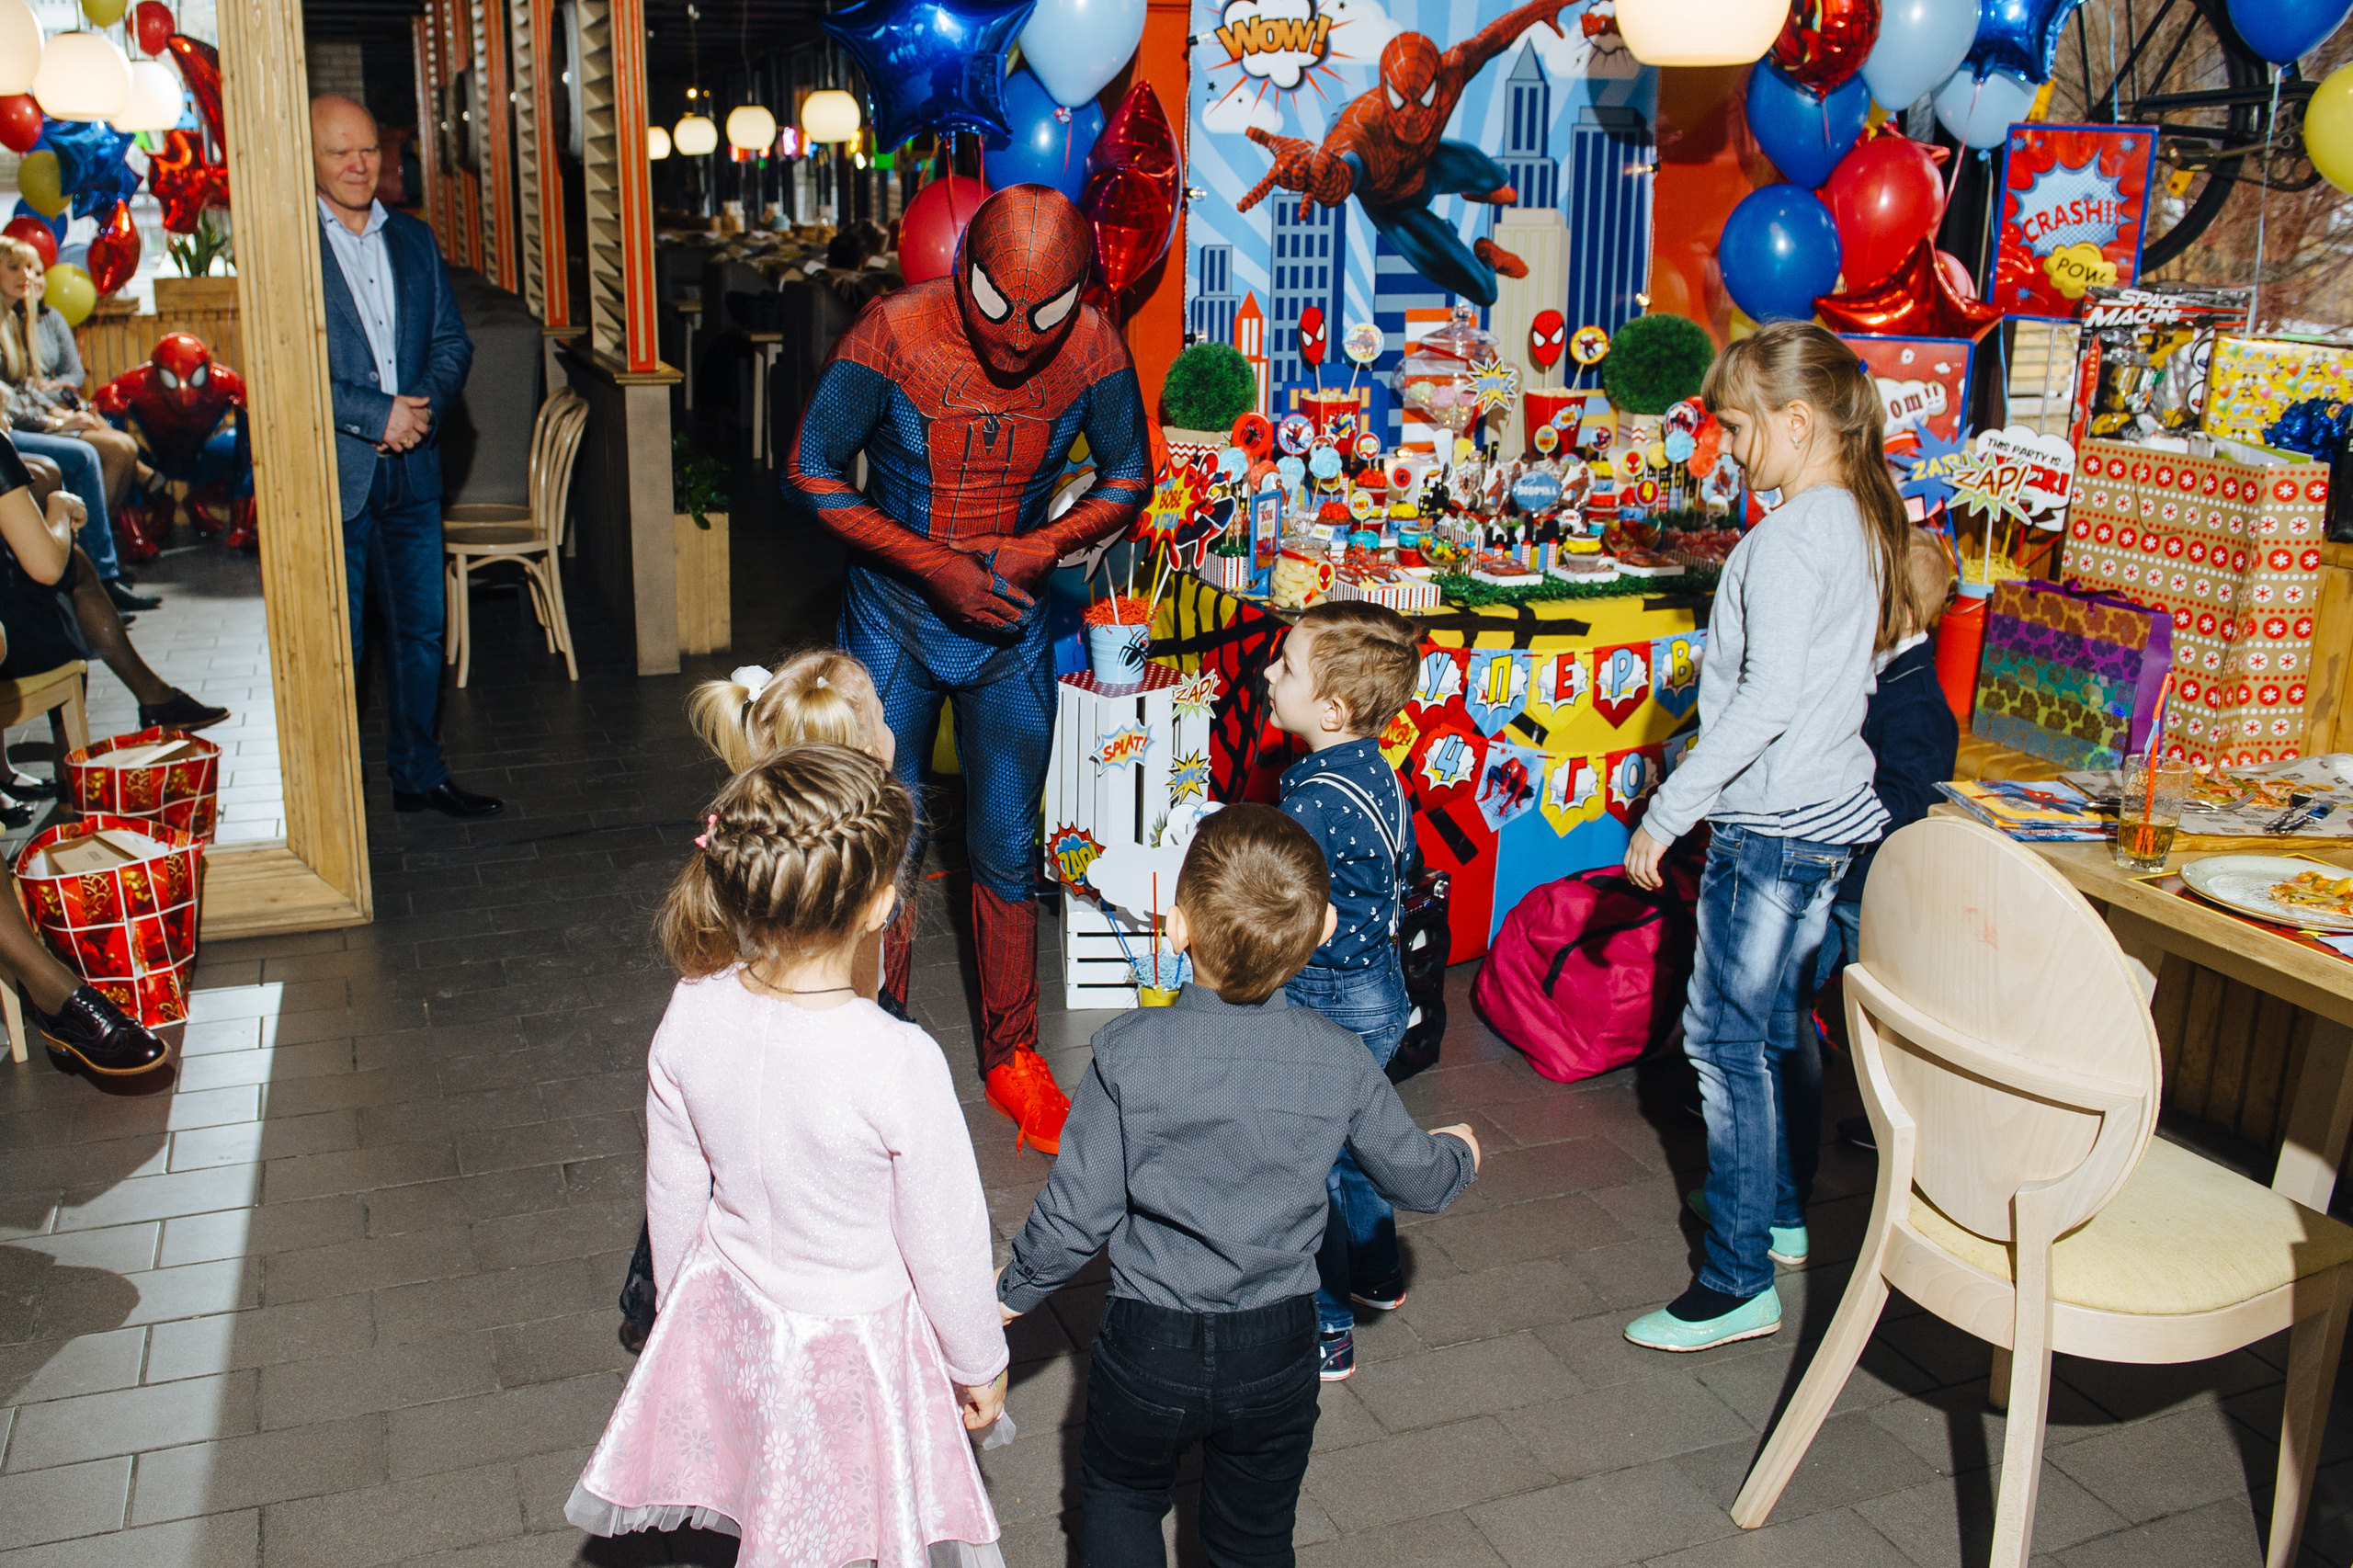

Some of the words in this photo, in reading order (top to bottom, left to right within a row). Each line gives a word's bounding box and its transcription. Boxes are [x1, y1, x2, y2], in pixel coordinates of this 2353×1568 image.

[1214, 14, 1333, 61] WOW!
[2023, 199, 2121, 243] CRASH!!
[2098, 289, 2181, 309] SPACE
[2084, 307, 2182, 328] MACHINE
[1988, 438, 2010, 451] THIS
[2012, 446, 2047, 460] PARTY
[2051, 456, 2062, 467] IS
[1954, 464, 2028, 504] ZAP!
[1176, 677, 1216, 706] ZAP!
[1103, 734, 1148, 761] SPLAT!
[1380, 724, 1416, 744] NG!
[1435, 733, 1467, 781] 4
[1175, 767, 1204, 788] BANG!
